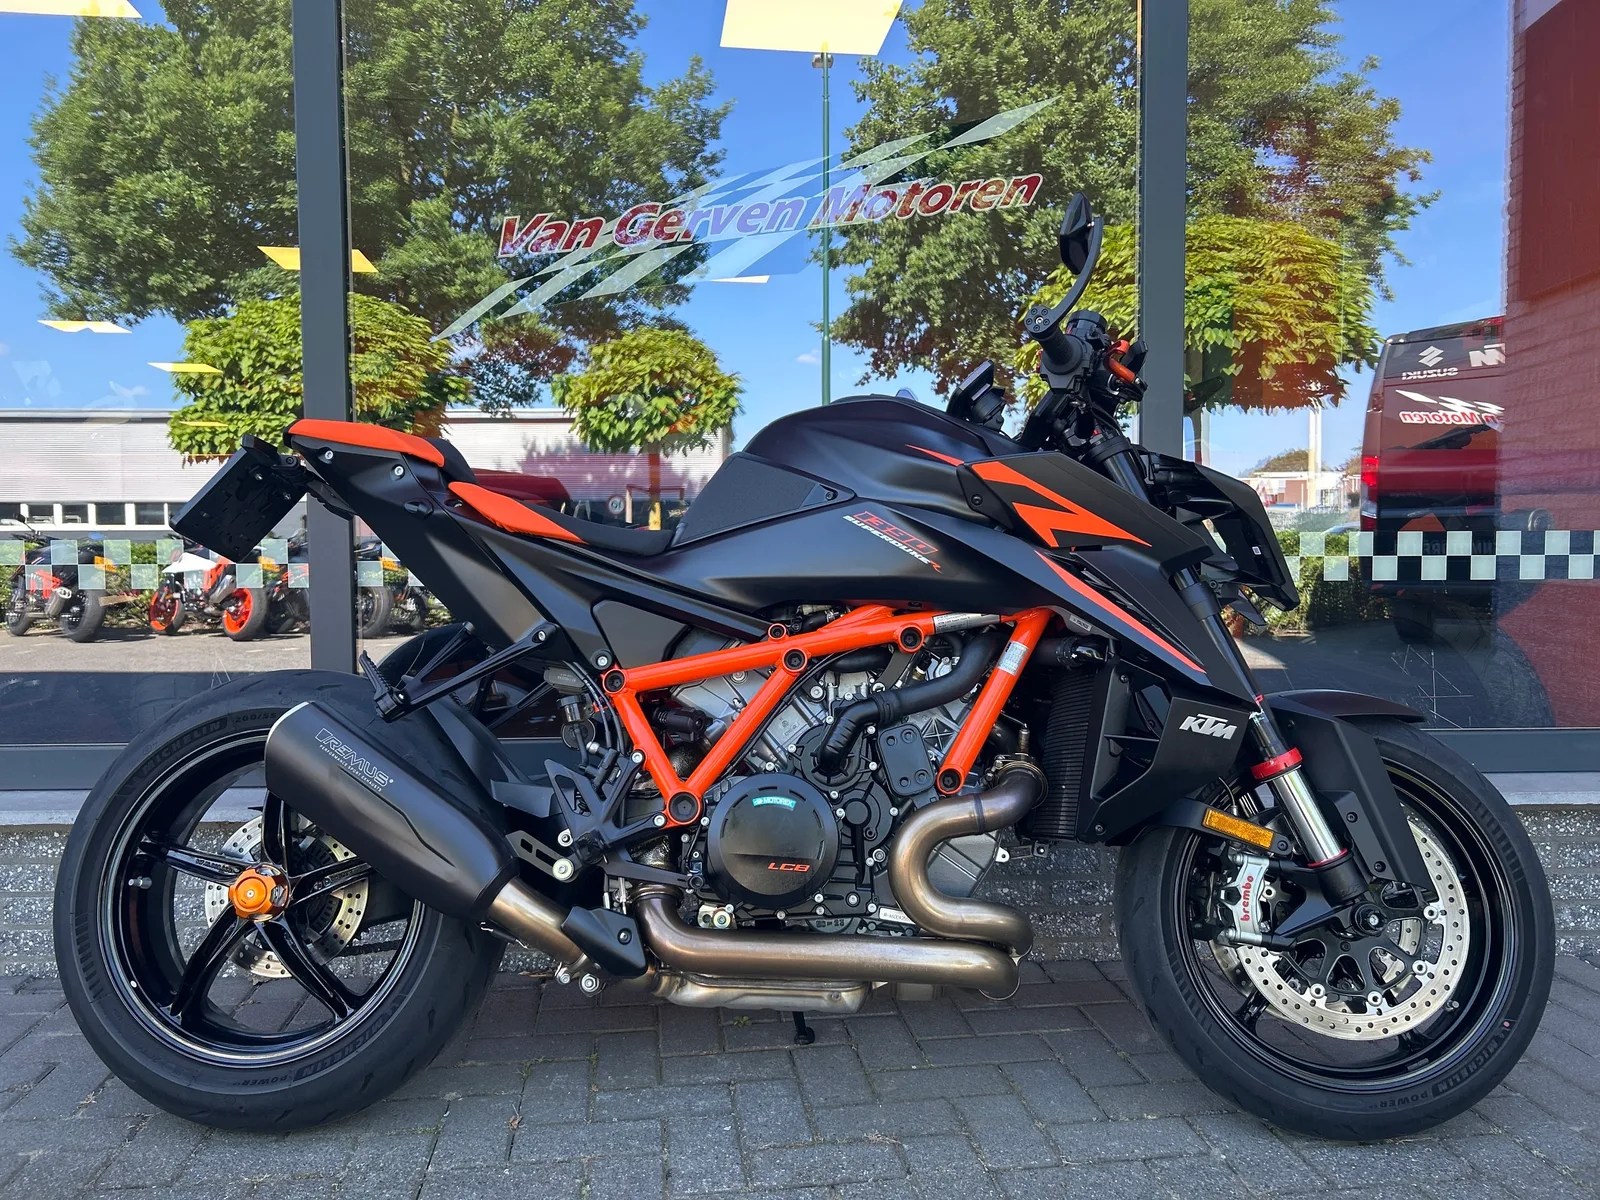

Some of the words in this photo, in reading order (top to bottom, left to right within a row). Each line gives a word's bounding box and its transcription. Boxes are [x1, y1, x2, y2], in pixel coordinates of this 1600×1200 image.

[499, 211, 605, 258] Van
[614, 196, 808, 246] Gerven
[812, 173, 1044, 227] Motoren
[143, 720, 221, 771] MICHELIN
[1179, 713, 1238, 740] KTM
[322, 736, 390, 787] REMUS
[763, 797, 792, 807] MOTOREX
[1240, 875, 1254, 922] brembo
[242, 1074, 288, 1086] POWER
[1437, 1040, 1499, 1092] MICHELIN
[1380, 1091, 1428, 1108] POWER
